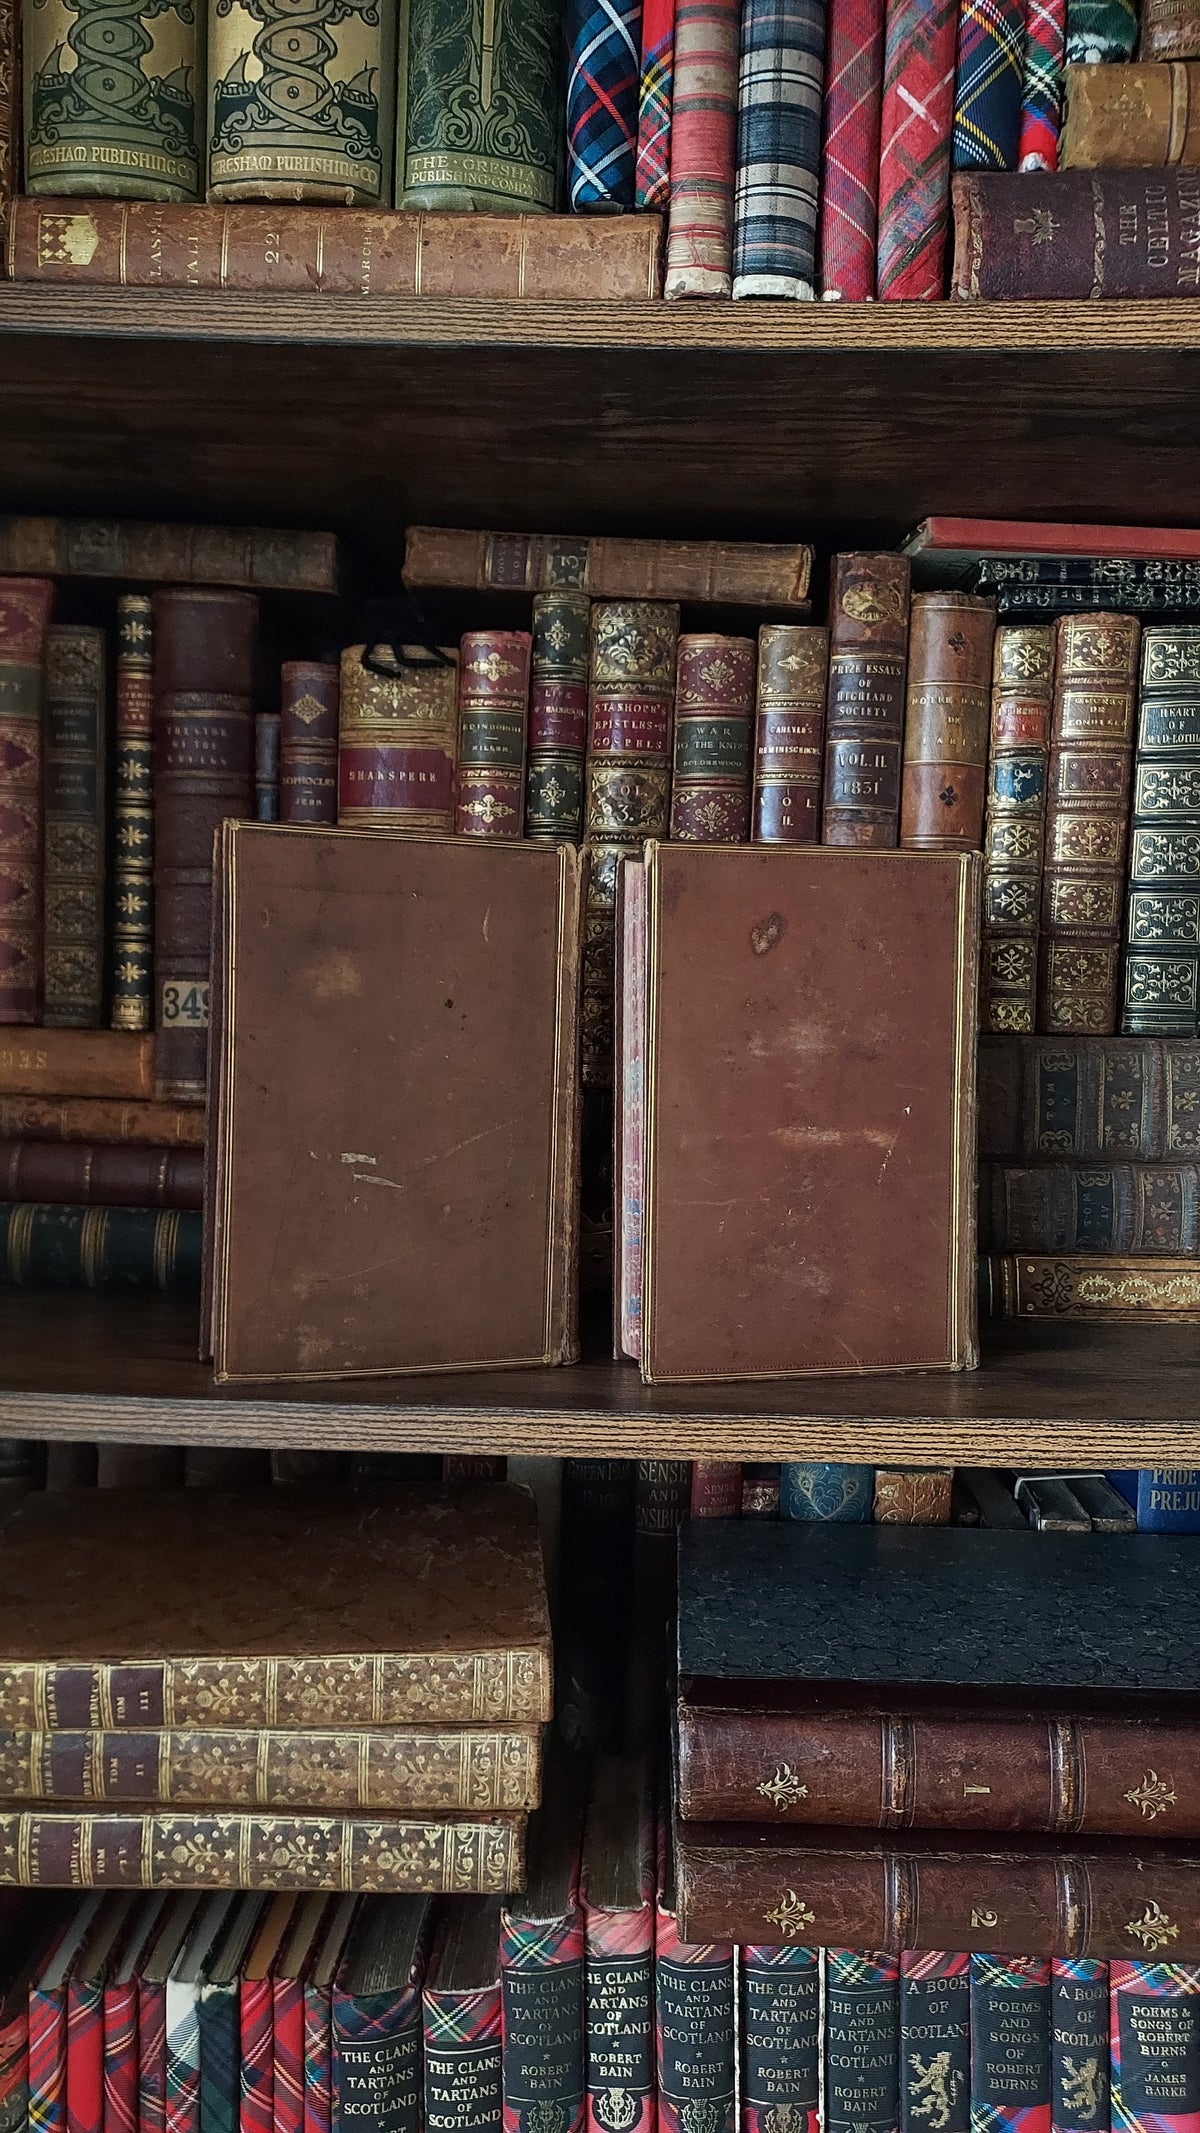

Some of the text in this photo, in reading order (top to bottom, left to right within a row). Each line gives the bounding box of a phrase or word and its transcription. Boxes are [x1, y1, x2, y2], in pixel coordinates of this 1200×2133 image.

[30, 146, 195, 179] GRESHAM PUBLISHING CO
[411, 156, 448, 171] THE
[213, 155, 378, 185] GRESHAM PUBLISHING CO
[1119, 204, 1138, 246] THE
[1145, 185, 1169, 268] CELTIC
[832, 664, 902, 676] PRIZE ESSAYS
[858, 678, 871, 688] OF
[837, 691, 893, 702] HIGHLAND
[911, 695, 952, 706] NOTRE
[594, 702, 667, 715] STANHOPE'S
[838, 706, 887, 718] SOCIETY
[1160, 707, 1196, 718] HEART
[696, 726, 732, 736] WAR
[769, 723, 813, 735] CARLYLE'S
[1168, 720, 1186, 730] OF
[593, 736, 662, 750] GOSPELS
[694, 740, 714, 750] THE
[838, 752, 872, 769] VOL.
[349, 770, 437, 783] SHAKSPERE
[639, 1460, 688, 1484] SENSE
[1152, 1469, 1197, 1486] PRIDE
[649, 1489, 679, 1502] AND
[116, 1696, 126, 1720] TOM
[109, 1757, 119, 1784] TOM
[96, 1848, 106, 1876] TOM
[970, 1908, 998, 1929] 2
[605, 1967, 651, 1985] CLANS
[661, 1972, 733, 1993] THE CLANS
[507, 1980, 536, 1995] THE
[600, 1986, 627, 1996] AND
[746, 1980, 774, 1995] THE
[906, 1980, 921, 1995] A
[1058, 1985, 1071, 2000] A
[534, 1994, 559, 2005] AND
[587, 1995, 649, 2010] ARTANS
[685, 1994, 711, 2004] AND
[771, 1998, 798, 2008] AND
[512, 2001, 579, 2020] TARTANS
[665, 2000, 732, 2019] TARTANS
[928, 2000, 950, 2014] OF
[988, 2000, 1041, 2014] POEMS
[1131, 2005, 1192, 2019] POEMS &
[606, 2011, 623, 2021] OF
[750, 2007, 818, 2024] TARTANS
[849, 2017, 876, 2027] AND
[1077, 2010, 1097, 2024] OF
[587, 2021, 652, 2036] COTLAND
[690, 2021, 707, 2031] OF
[1000, 2017, 1031, 2029] AND
[1129, 2018, 1195, 2031] SONGS OF
[509, 2029, 580, 2047] SCOTLAND
[663, 2025, 733, 2045] SCOTLAND
[776, 2026, 792, 2036] OF
[828, 2026, 896, 2042] TARTANS
[989, 2031, 1041, 2043] SONGS
[1136, 2031, 1191, 2043] ROBERT
[746, 2033, 819, 2050] SCOTLAND
[853, 2043, 871, 2054] OF
[342, 2039, 418, 2064] THE CLANS
[1005, 2048, 1026, 2060] OF
[1140, 2044, 1187, 2057] BURNS
[427, 2055, 502, 2075] THE CLANS
[590, 2052, 643, 2065] ROBERT
[368, 2063, 395, 2075] AND
[520, 2061, 572, 2076] ROBERT
[599, 2065, 634, 2078] BAIN
[674, 2060, 725, 2075] ROBERT
[757, 2066, 810, 2080] ROBERT
[986, 2062, 1044, 2075] ROBERT
[346, 2066, 415, 2089] TARTANS
[451, 2075, 478, 2087] AND
[530, 2077, 563, 2090] BAIN
[682, 2076, 716, 2089] BAIN
[1144, 2073, 1187, 2084] JAMES
[430, 2082, 499, 2102] TARTANS
[767, 2081, 801, 2093] BAIN
[834, 2085, 888, 2099] ROBERT
[988, 2078, 1040, 2092] BURNS
[1144, 2085, 1188, 2098] BARKE
[373, 2090, 390, 2101] OF
[343, 2092, 418, 2115] SCOTLAND
[456, 2102, 473, 2113] OF
[843, 2100, 878, 2112] BAIN
[428, 2108, 502, 2129] SCOTLAND
